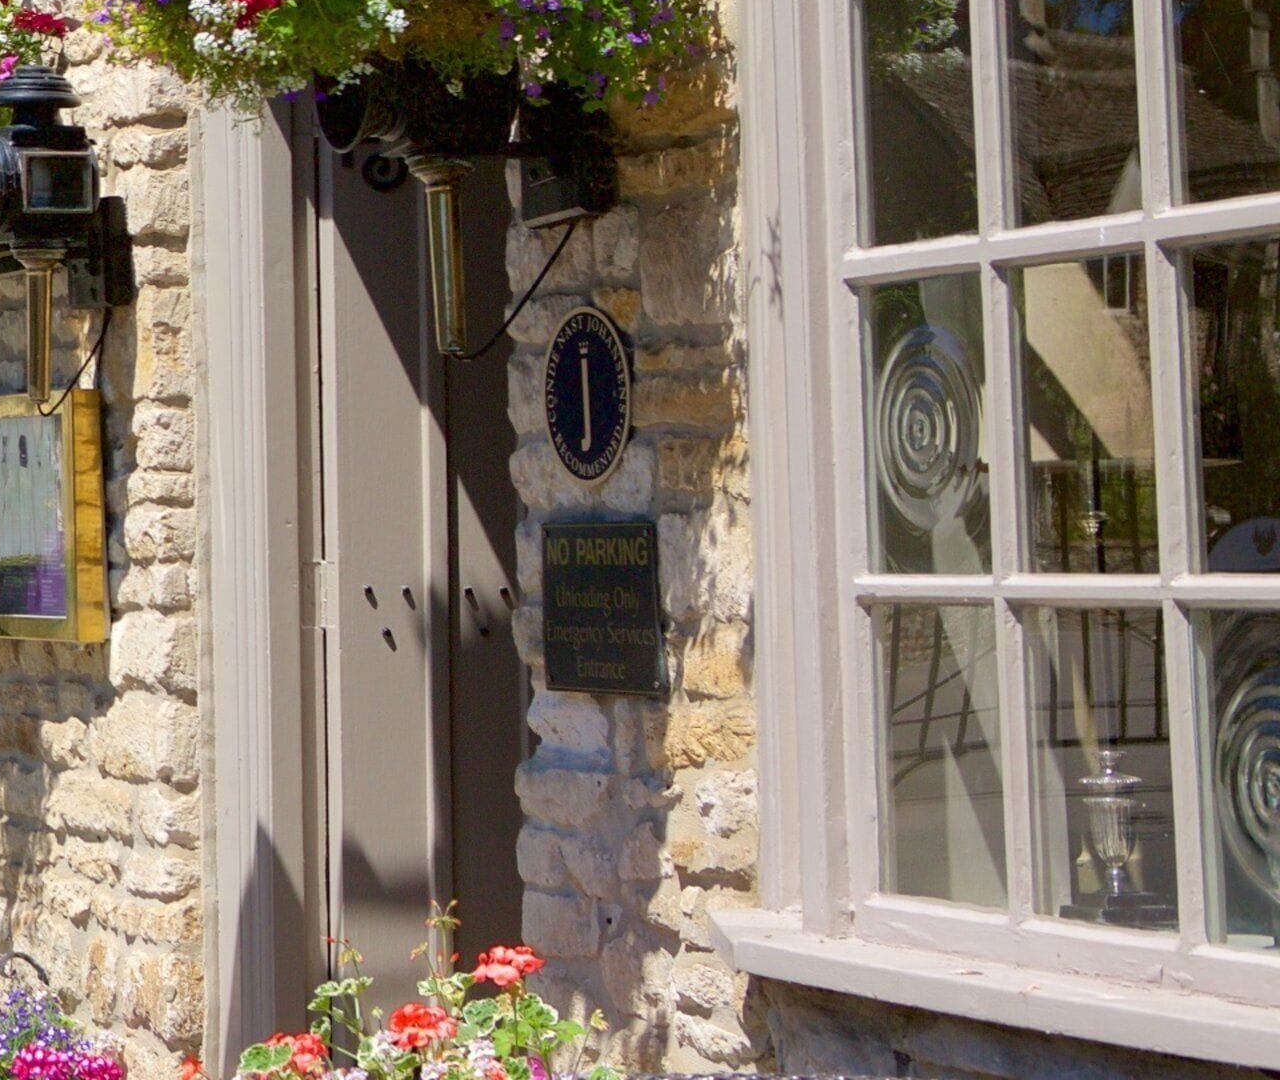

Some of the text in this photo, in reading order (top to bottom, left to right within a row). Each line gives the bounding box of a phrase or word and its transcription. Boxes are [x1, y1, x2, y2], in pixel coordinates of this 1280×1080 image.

[556, 316, 584, 347] NAST
[587, 317, 626, 413] JOHANSENS
[554, 427, 623, 477] RECOMMENDED
[546, 538, 648, 566] NO PARKING
